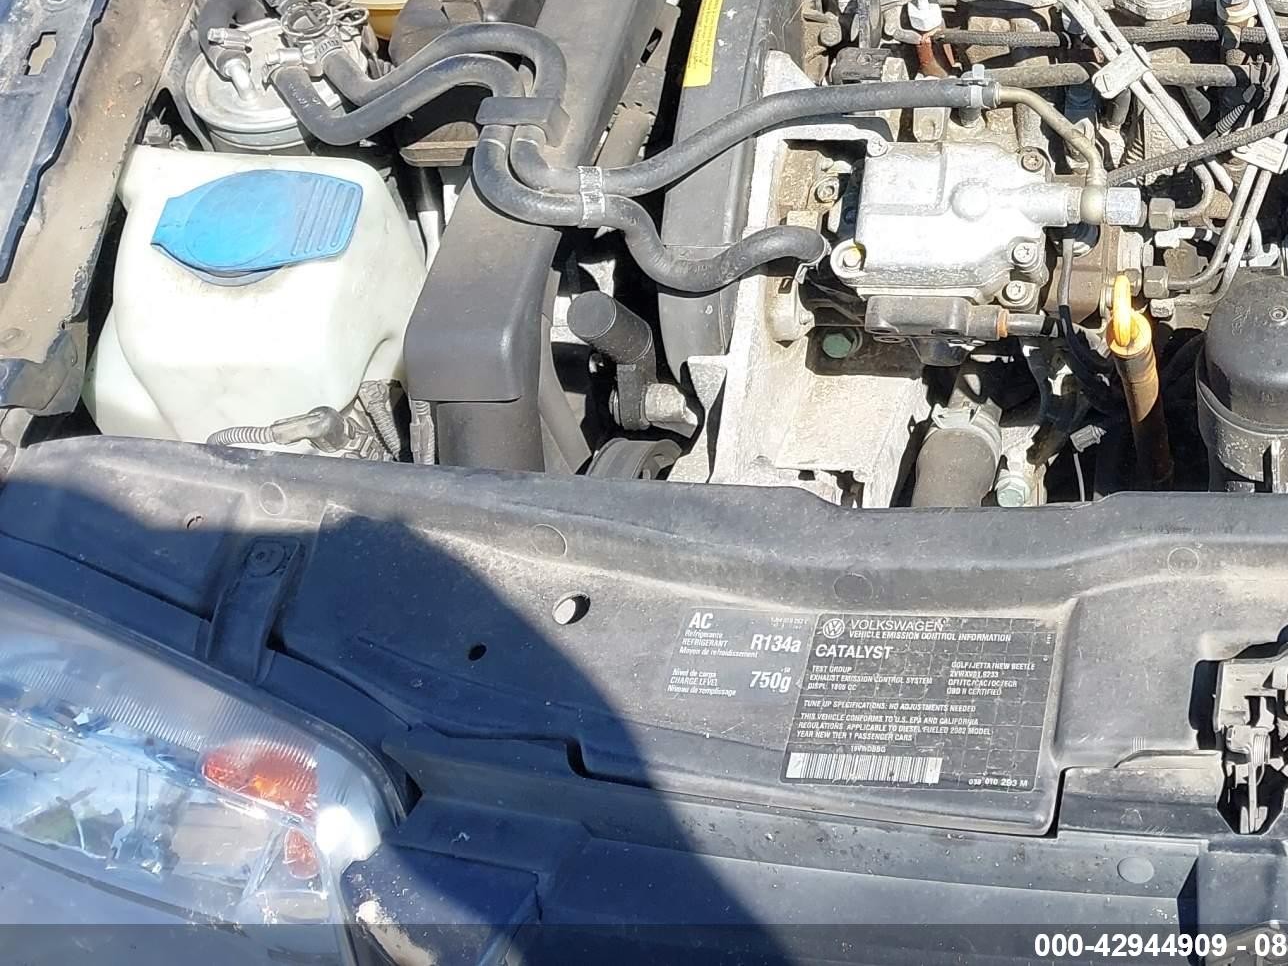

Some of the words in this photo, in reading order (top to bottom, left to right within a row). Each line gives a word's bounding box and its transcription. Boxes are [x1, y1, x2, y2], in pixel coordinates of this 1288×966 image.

[689, 612, 713, 629] AC
[850, 619, 943, 631] VOLKSWAGEN
[881, 631, 919, 640] EMISSION
[921, 632, 956, 641] CONTROL
[958, 633, 1011, 642] INFORMATION
[682, 638, 728, 647] REFRIGERANT
[750, 634, 801, 653] R134a
[815, 644, 893, 659] CATALYST
[1011, 663, 1036, 671] BEETLE
[670, 676, 698, 685] CHARGE
[699, 678, 718, 686] LEVEL
[750, 671, 792, 693] 750g
[810, 674, 839, 682] EXHAUST
[874, 676, 904, 684] CONTROL
[967, 688, 1002, 696] CERTIFIED
[822, 700, 832, 708] UP
[888, 702, 898, 710] NO
[899, 703, 948, 712] ADJUSTMENTS
[800, 712, 816, 720] THIS
[816, 713, 845, 721] VEHICLE
[845, 714, 883, 722] CONFORMS
[885, 715, 893, 723] TO
[923, 717, 938, 725] AND
[846, 724, 886, 732] APPLICABLE
[797, 730, 814, 738] YEAR
[832, 731, 848, 739] TIER
[853, 732, 893, 741] PASSENGER
[895, 733, 912, 741] CARS
[1000, 779, 1018, 787] 293
[1019, 779, 1028, 787] M
